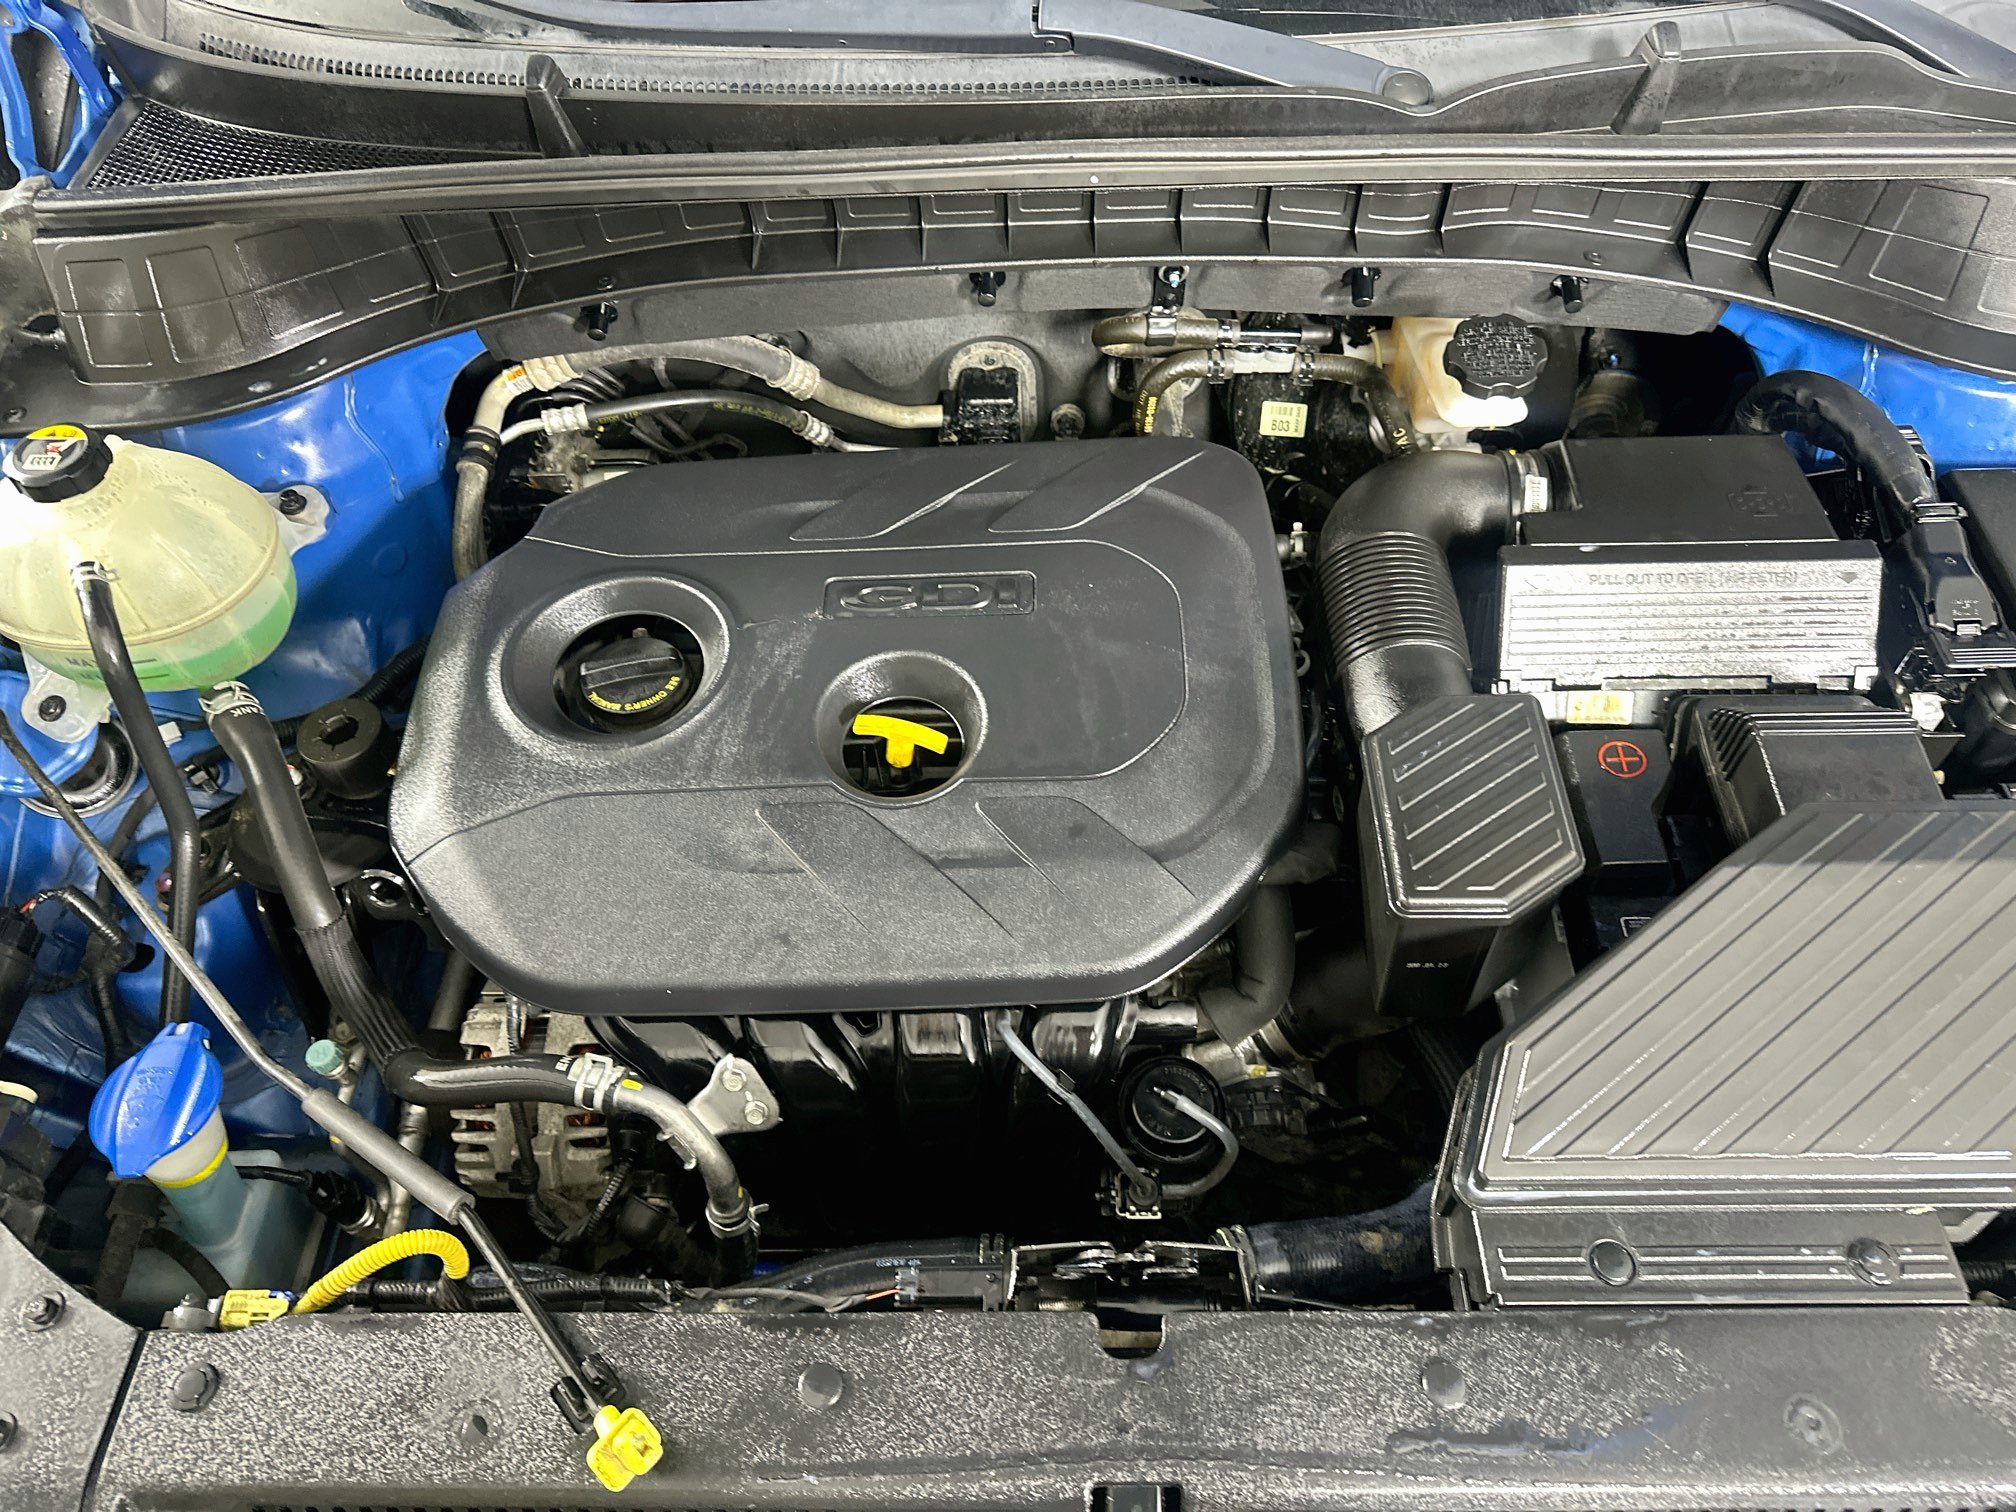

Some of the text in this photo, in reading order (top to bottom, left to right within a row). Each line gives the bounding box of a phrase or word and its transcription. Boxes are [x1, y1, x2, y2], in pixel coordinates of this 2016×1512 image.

[1588, 573, 1622, 586] PULL
[1625, 573, 1654, 585] OUT
[229, 704, 261, 718] ANK
